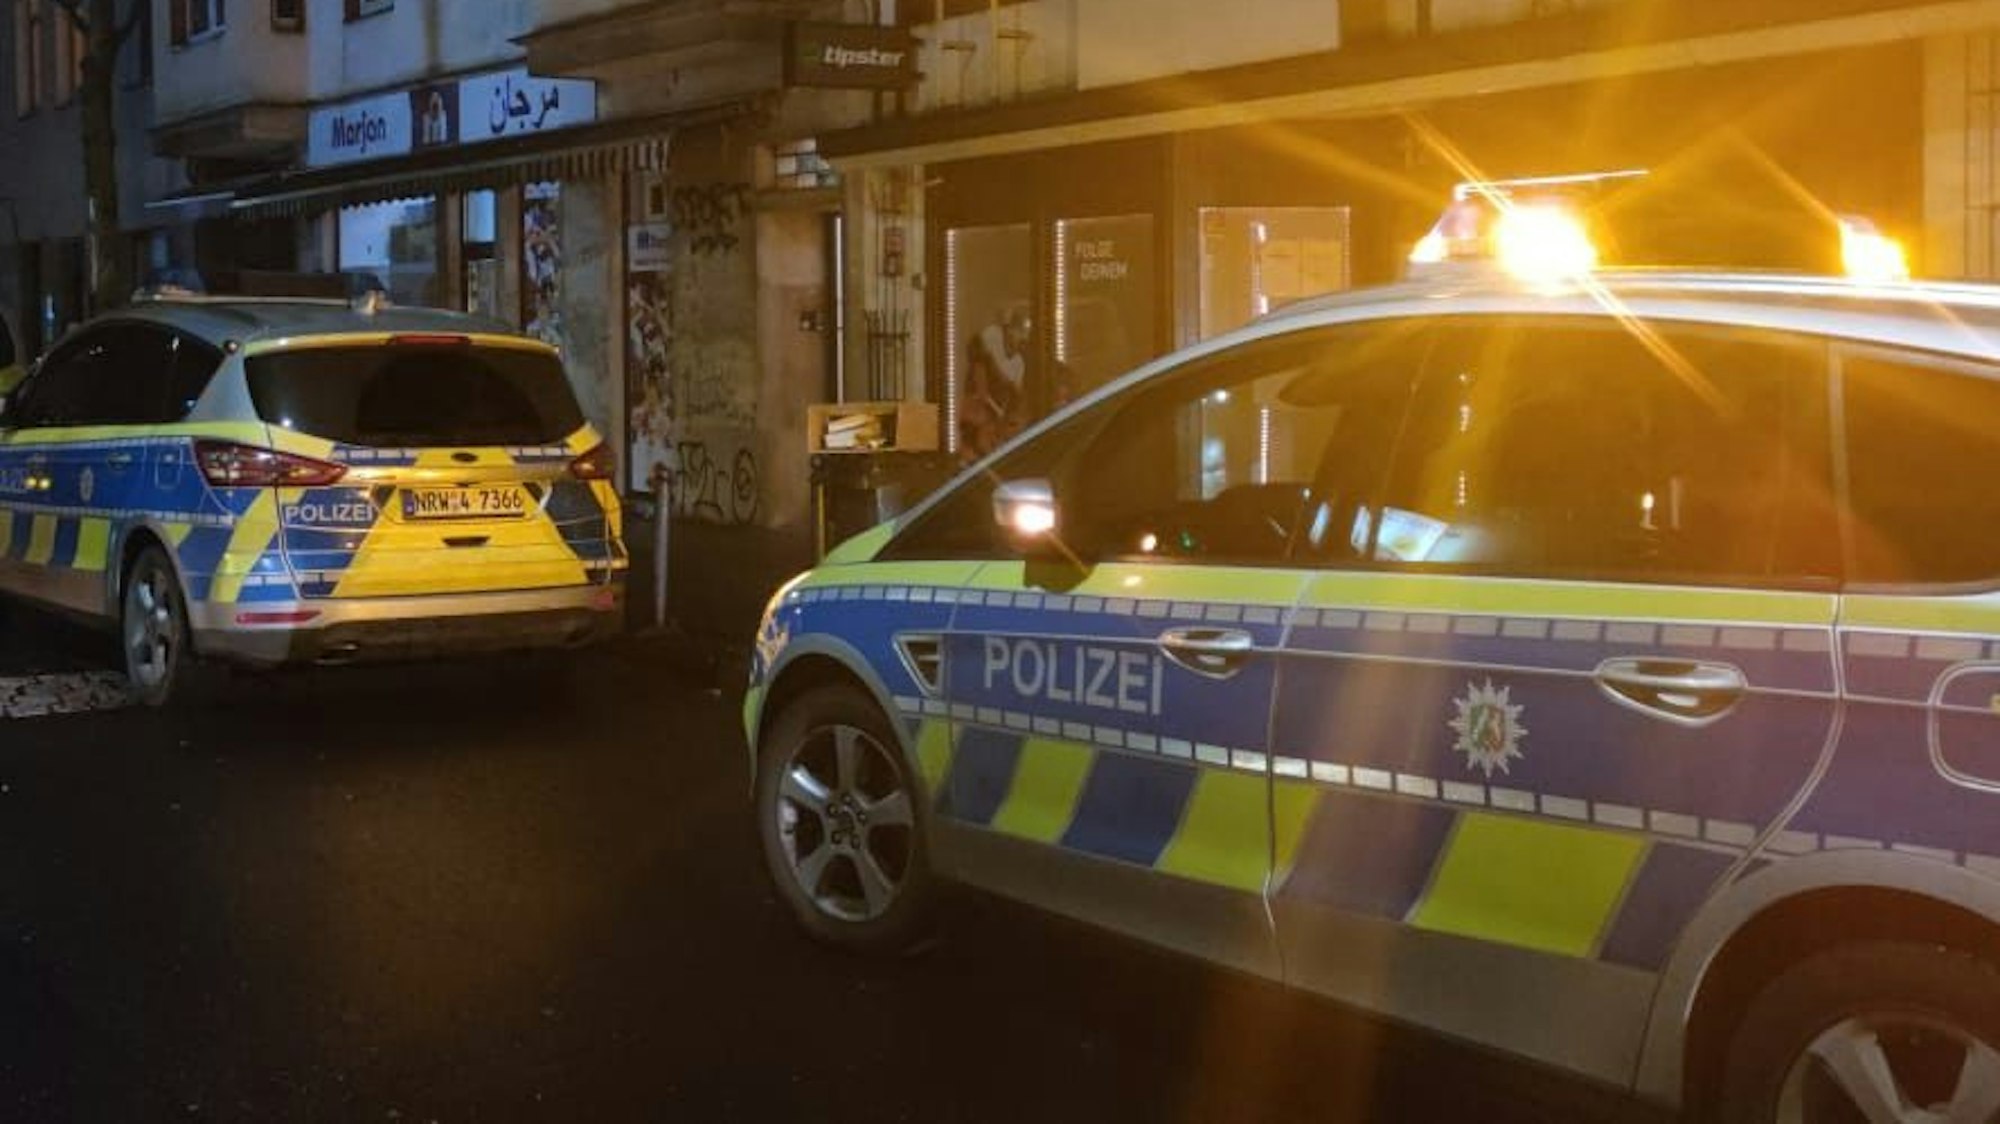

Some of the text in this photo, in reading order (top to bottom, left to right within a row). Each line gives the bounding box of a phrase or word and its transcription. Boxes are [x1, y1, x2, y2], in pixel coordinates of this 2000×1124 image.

[825, 46, 904, 67] tipster
[489, 75, 560, 134] مرجان
[331, 111, 386, 153] Marjan
[284, 502, 373, 522] POLIZEI
[414, 488, 523, 512] NRW 4 7366
[984, 635, 1164, 715] POLIZEI
